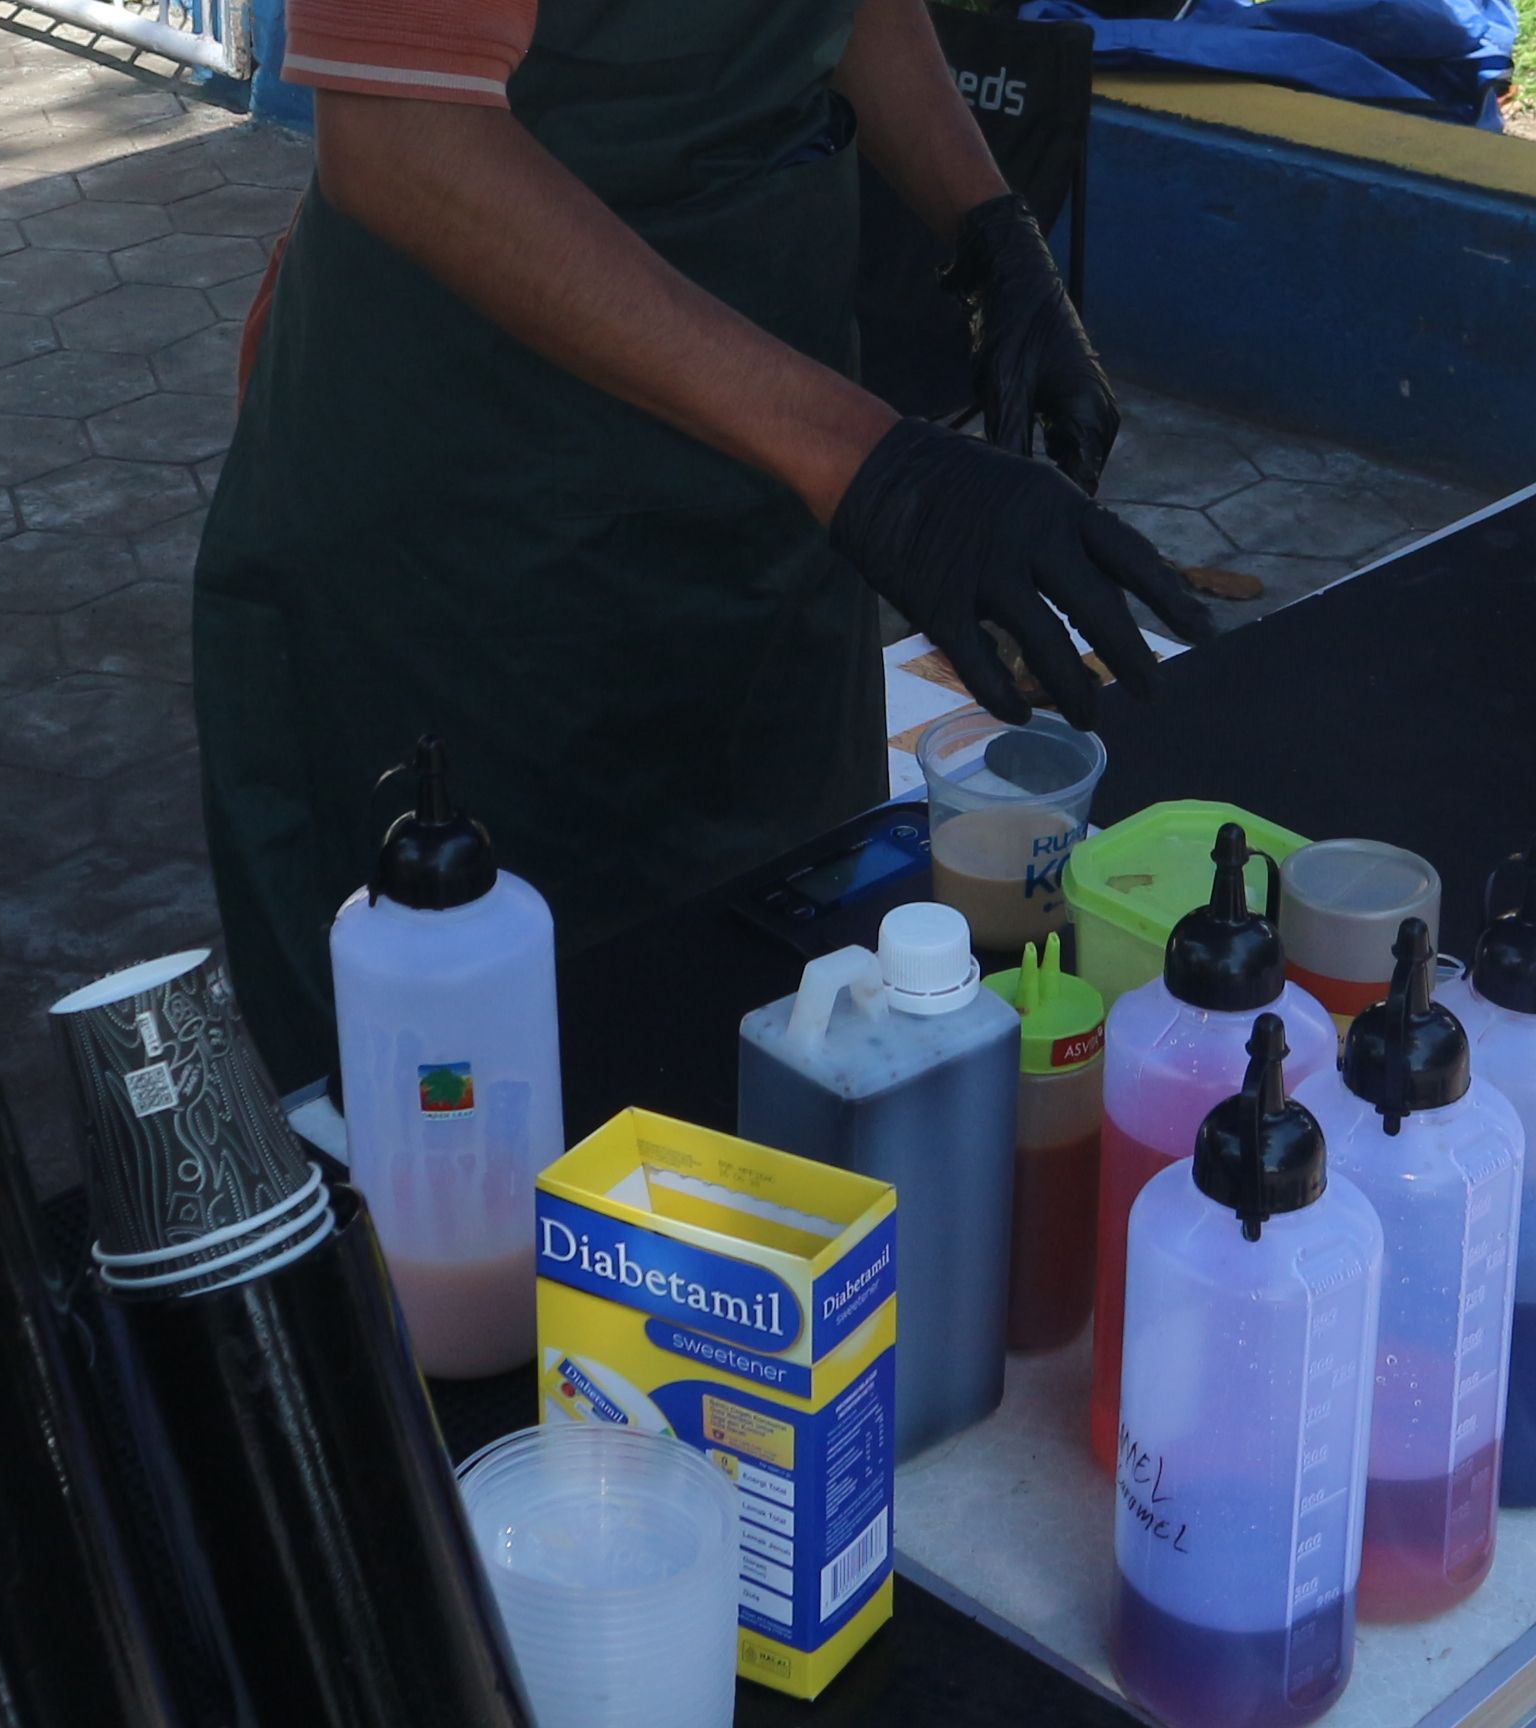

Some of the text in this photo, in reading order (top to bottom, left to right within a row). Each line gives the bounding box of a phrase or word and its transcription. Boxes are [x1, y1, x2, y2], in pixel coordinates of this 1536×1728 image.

[949, 67, 1027, 116] eds
[539, 1216, 784, 1337] Diabetamil
[823, 1243, 890, 1321] Diabetamil
[671, 1331, 788, 1384] sweetener
